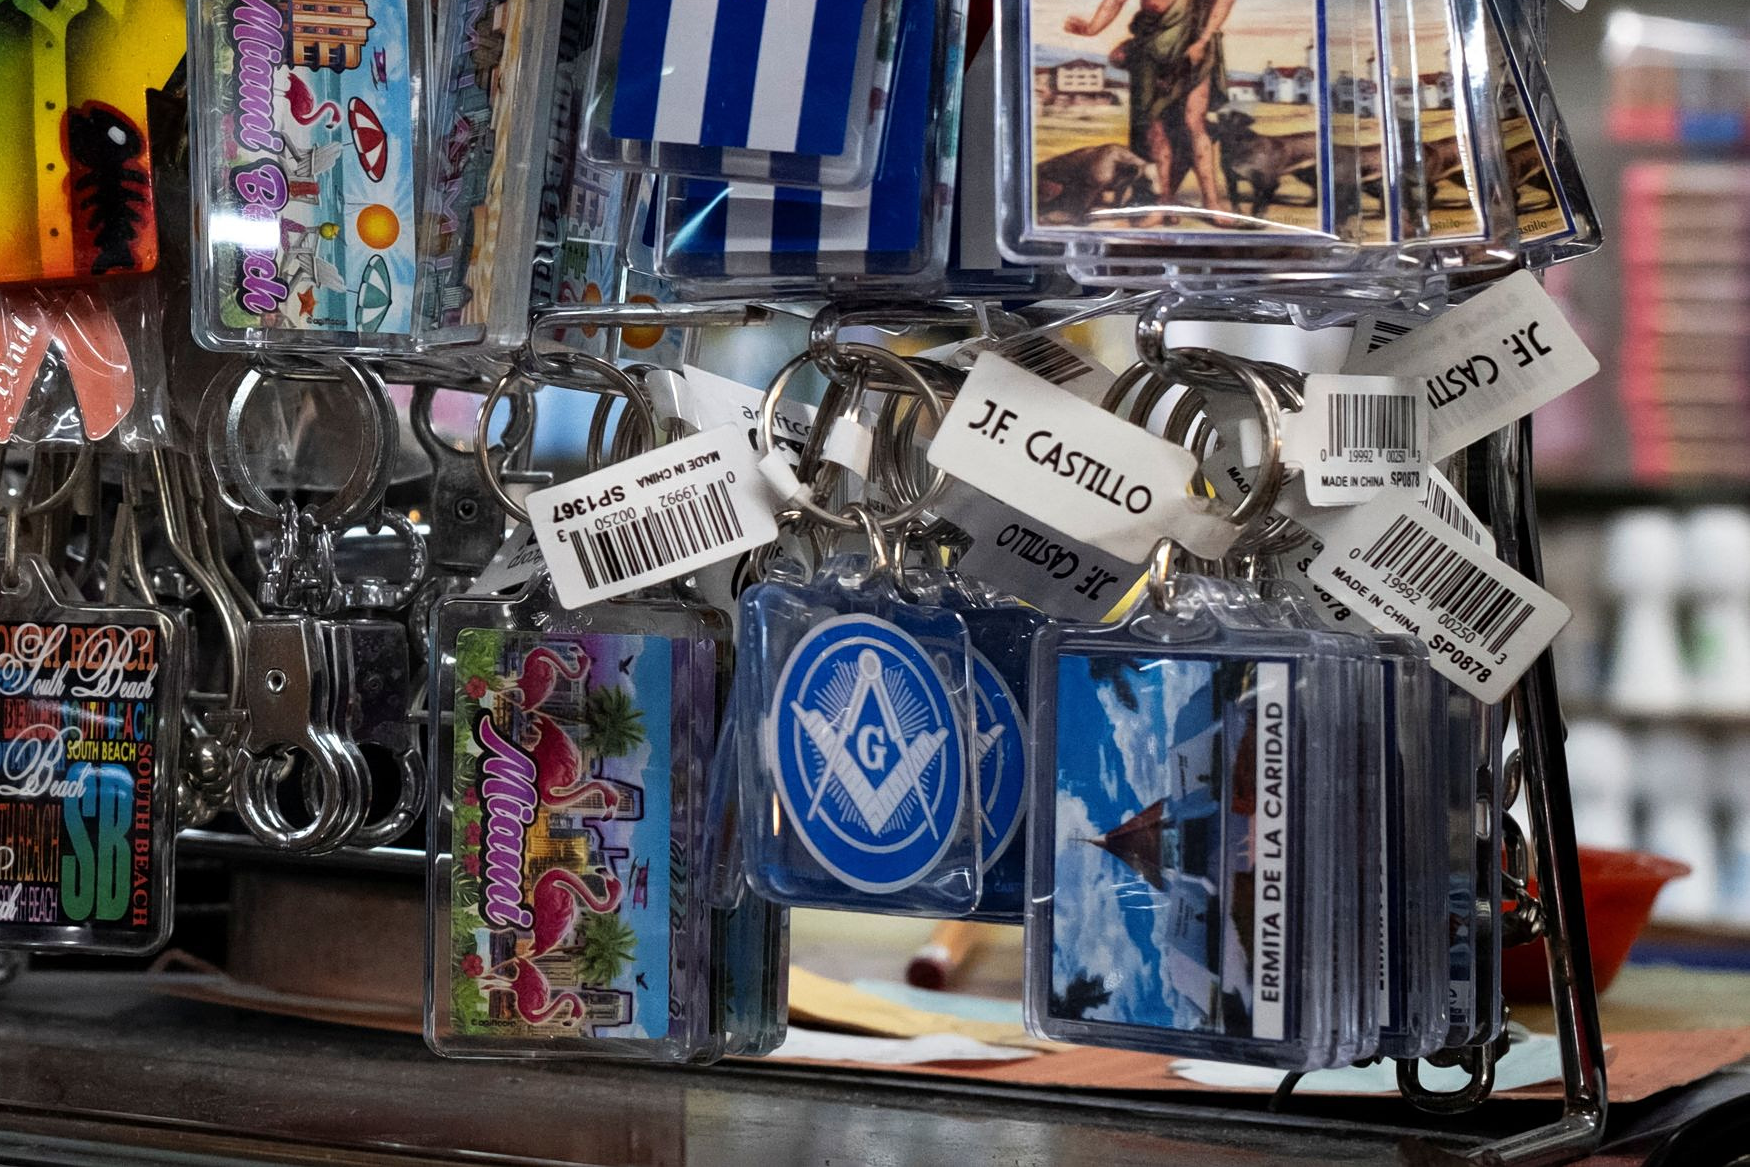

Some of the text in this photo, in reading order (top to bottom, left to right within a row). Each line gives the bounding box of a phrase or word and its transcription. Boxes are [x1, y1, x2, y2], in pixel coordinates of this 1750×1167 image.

[233, 162, 289, 314] Bch
[1518, 218, 1548, 235] astillo
[1427, 320, 1552, 410] J.F. CASTI
[553, 451, 720, 523] MADE IN CHINA SP1367
[968, 399, 1152, 514] J.F. CASTILLO
[1227, 466, 1251, 495] MAD
[1321, 471, 1420, 488] MADE IN CHINA SP0878
[1348, 450, 1373, 463] 19992
[595, 507, 636, 531] 00250
[659, 484, 698, 508] 19992
[996, 523, 1118, 601] J.F. CASTILLO
[1331, 566, 1492, 683] MADE IN CHINA SP0878
[1381, 573, 1421, 605] 19992
[1437, 613, 1477, 644] 00250
[71, 625, 158, 699] Beach
[67, 740, 99, 760] SOUTH
[102, 741, 136, 761] BEACH
[857, 725, 888, 772] G
[61, 762, 134, 921] SB
[133, 743, 152, 926] SOUTH BEACH
[479, 714, 535, 928] Miami
[1260, 700, 1286, 1004] ERMITA DE LA CARIDAD
